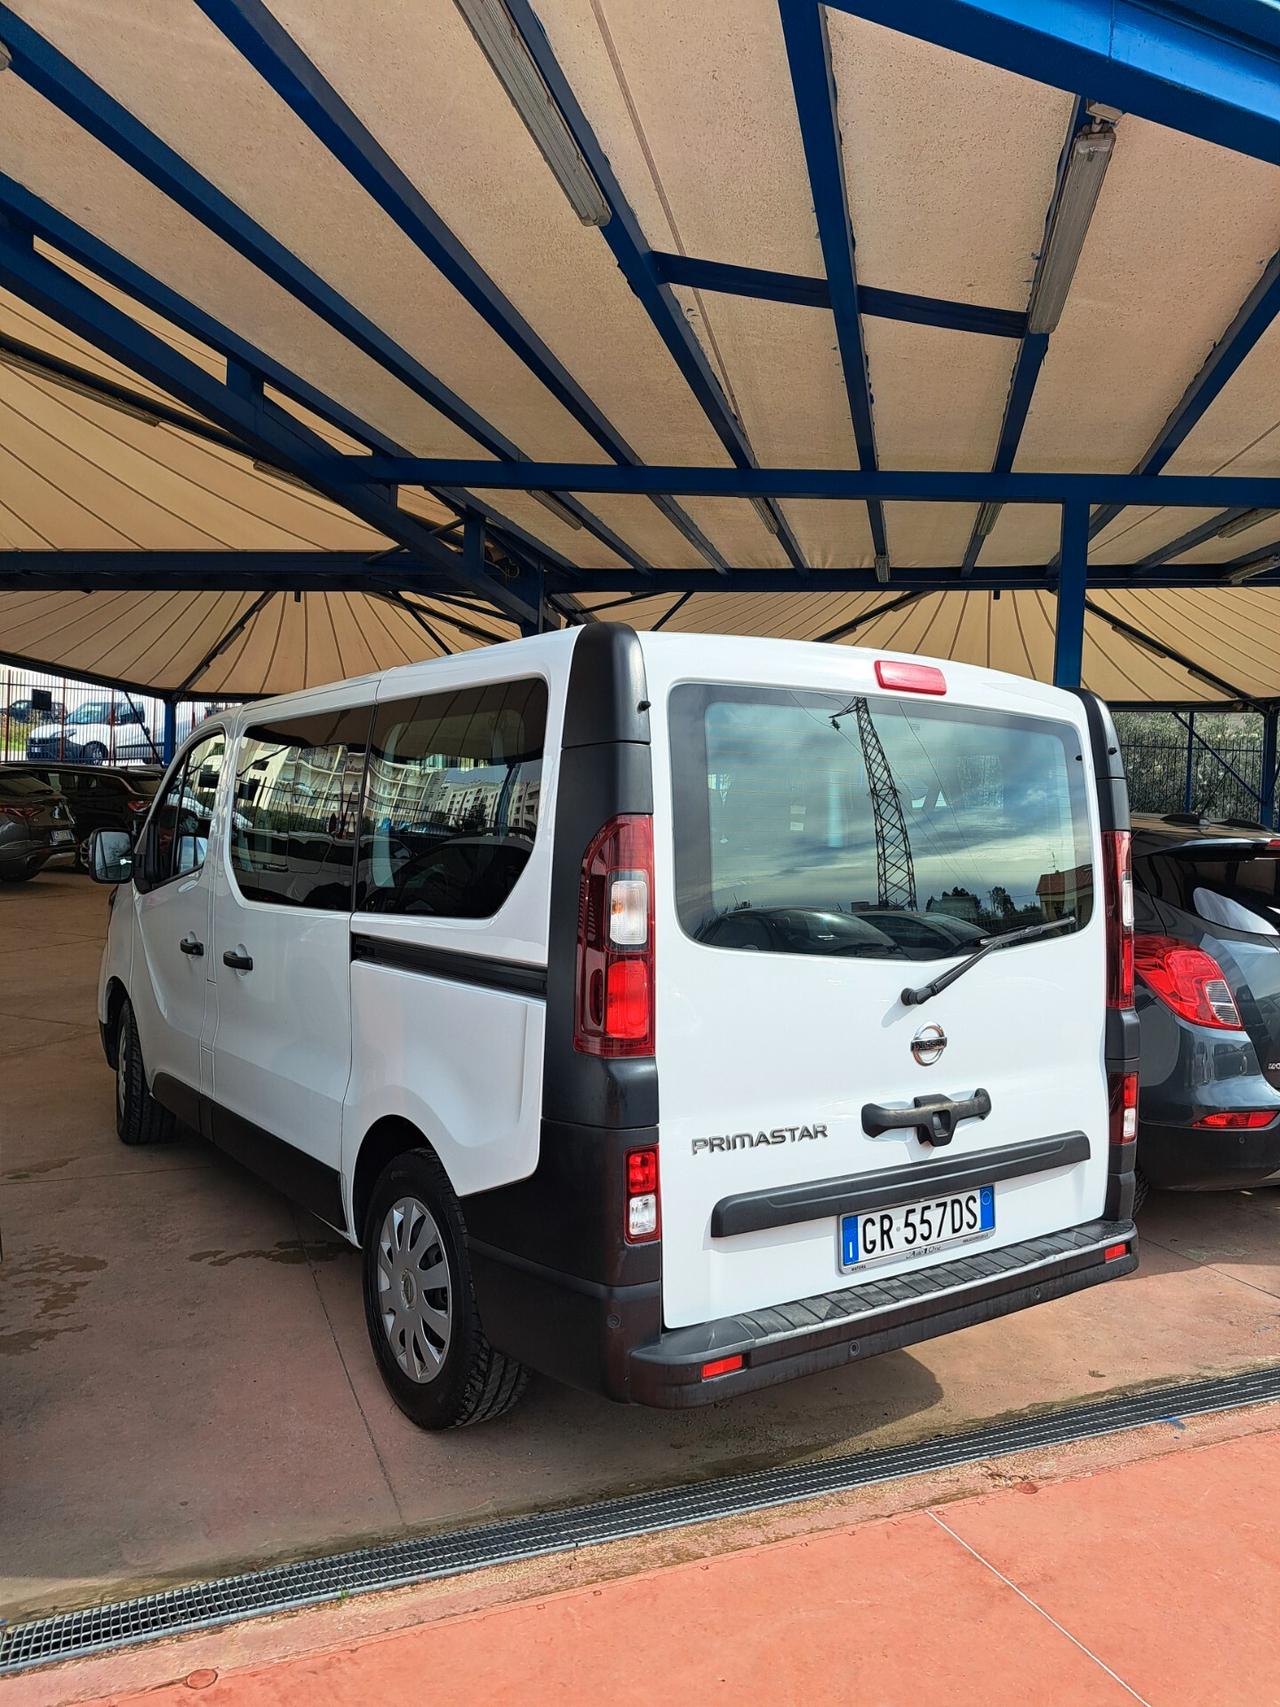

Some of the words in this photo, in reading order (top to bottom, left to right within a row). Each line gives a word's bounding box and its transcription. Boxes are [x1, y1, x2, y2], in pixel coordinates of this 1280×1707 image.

[691, 1123, 828, 1155] PRIMASTAR
[862, 1214, 894, 1254] GR
[904, 1195, 978, 1245] 557DS
